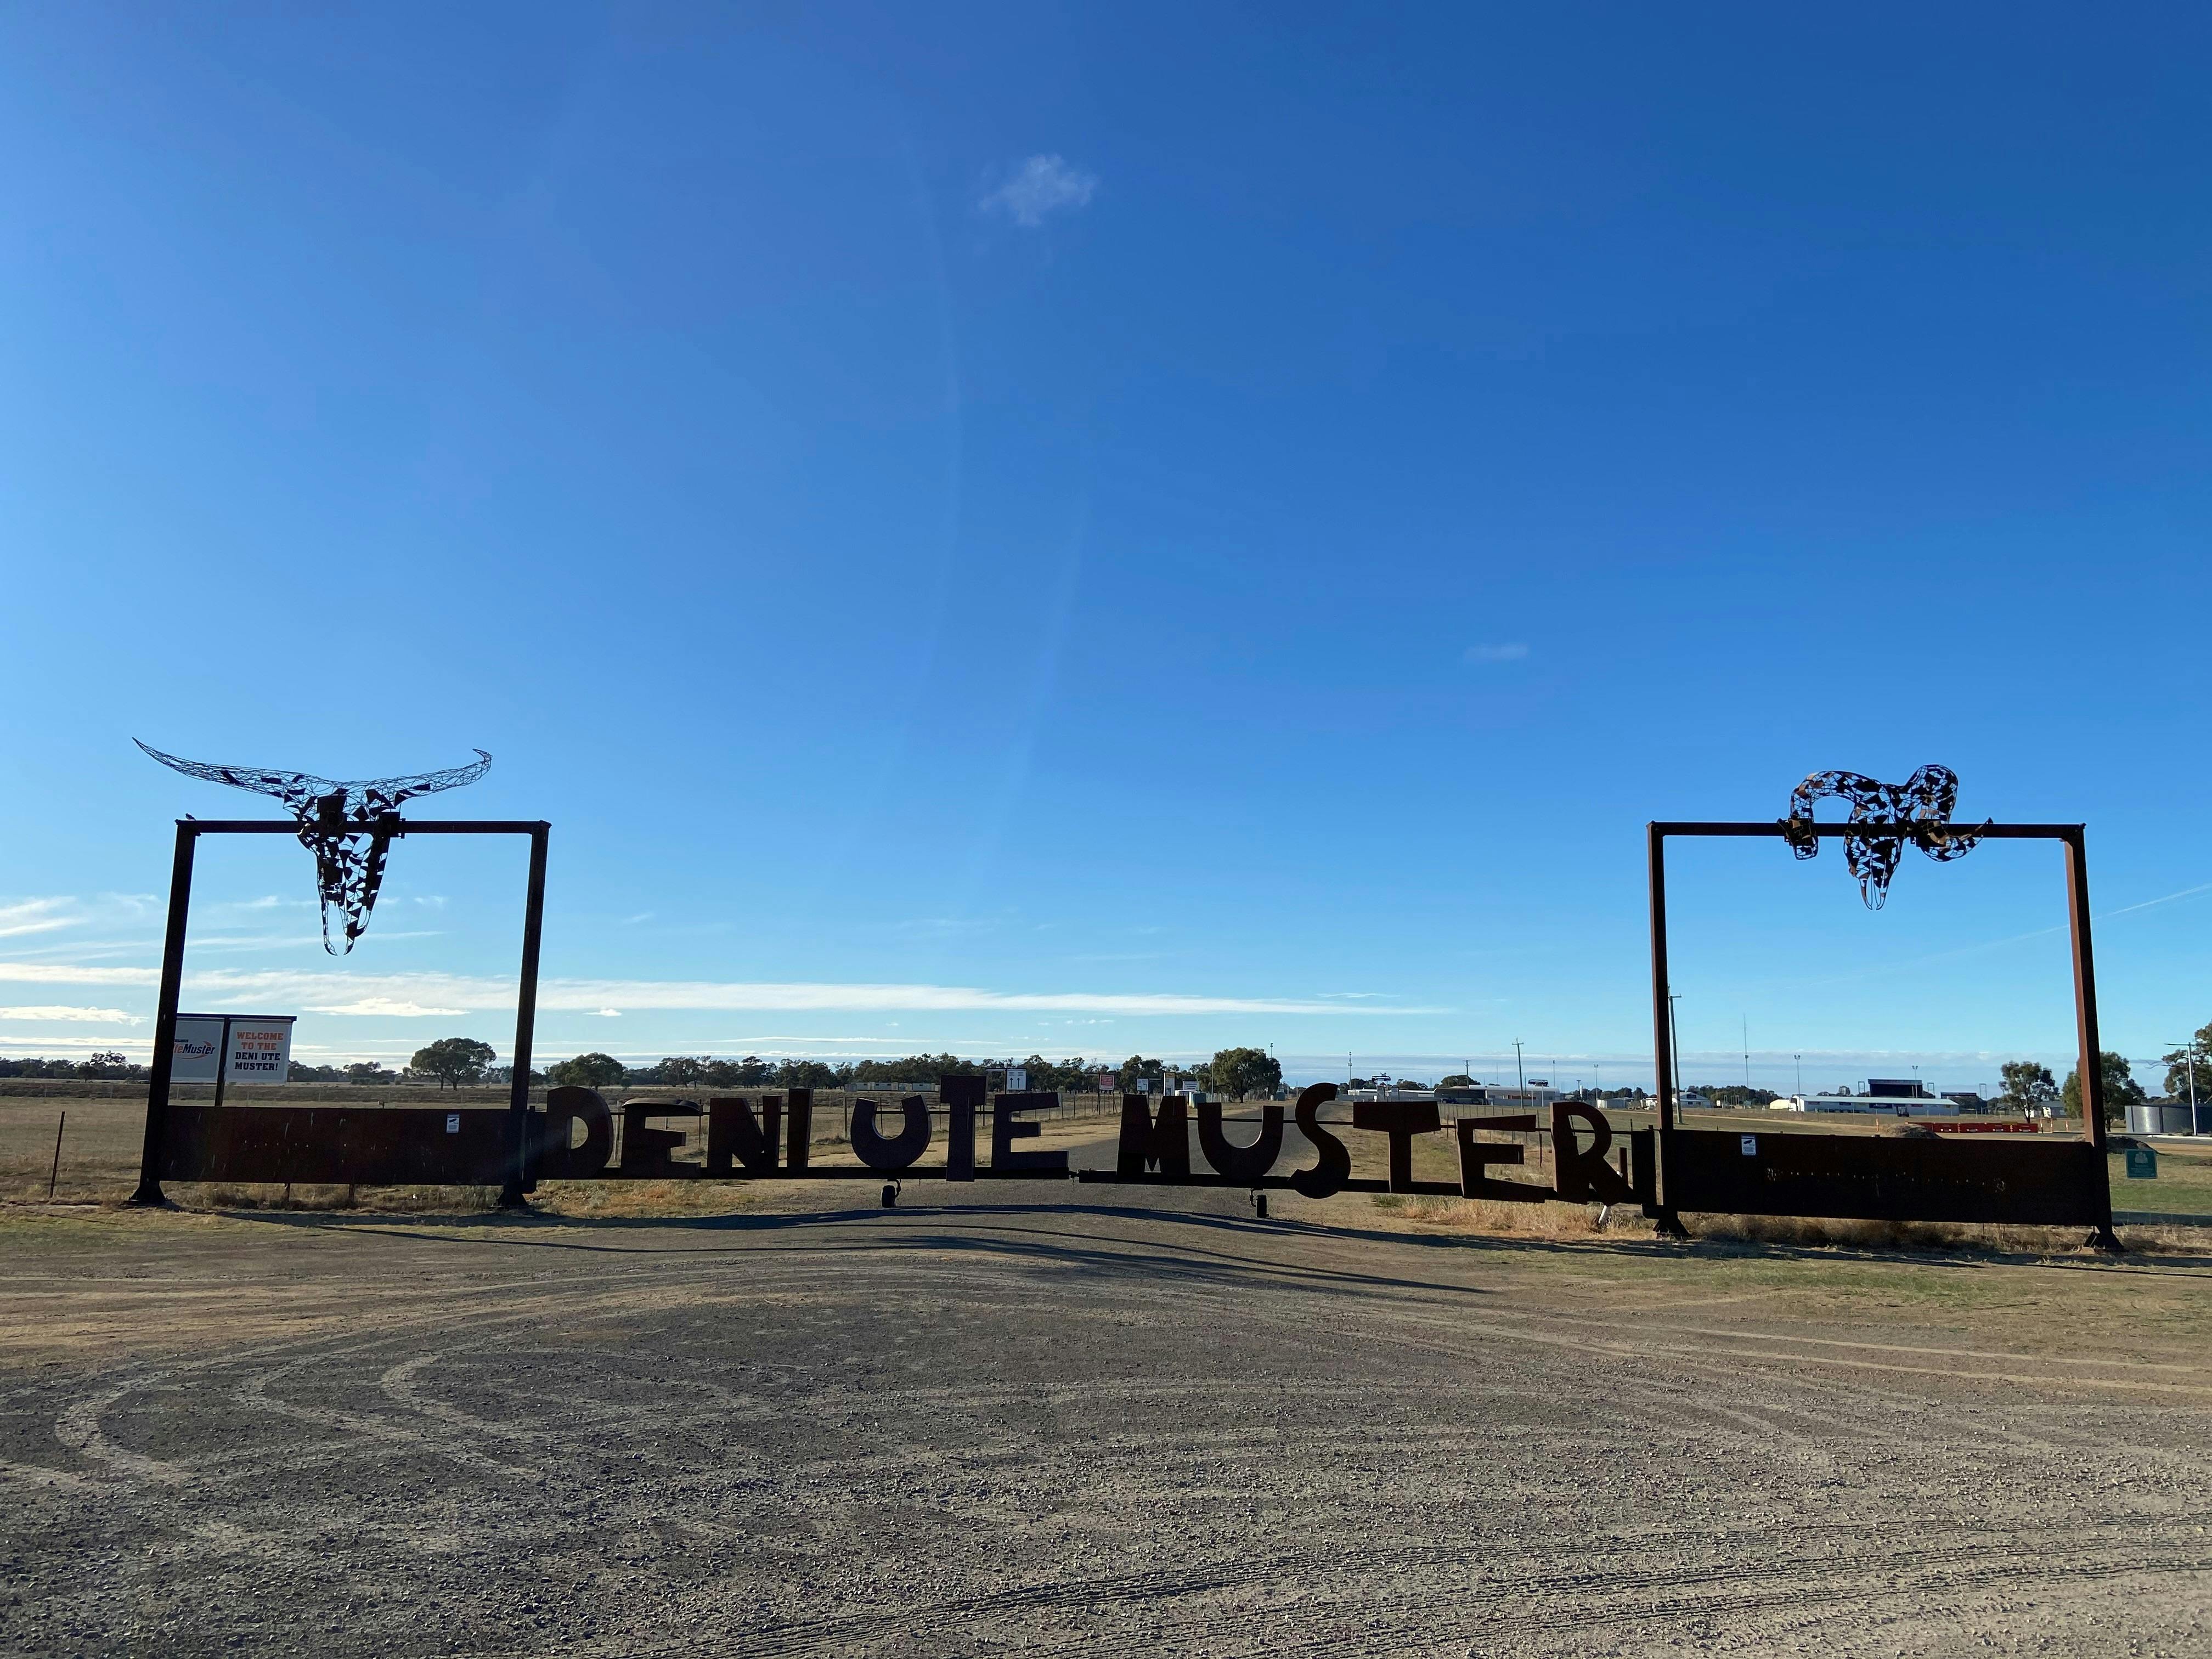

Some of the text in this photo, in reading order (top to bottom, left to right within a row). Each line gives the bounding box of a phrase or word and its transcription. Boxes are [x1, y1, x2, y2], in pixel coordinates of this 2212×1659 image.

[236, 1031, 284, 1041] WELCOME
[173, 1043, 216, 1054] teMuster
[241, 1042, 277, 1051] TO THE
[235, 1052, 281, 1061] DENI UTE
[234, 1062, 279, 1071] MUSTER!
[547, 1075, 1634, 1205] DENI UTE MUSTER
